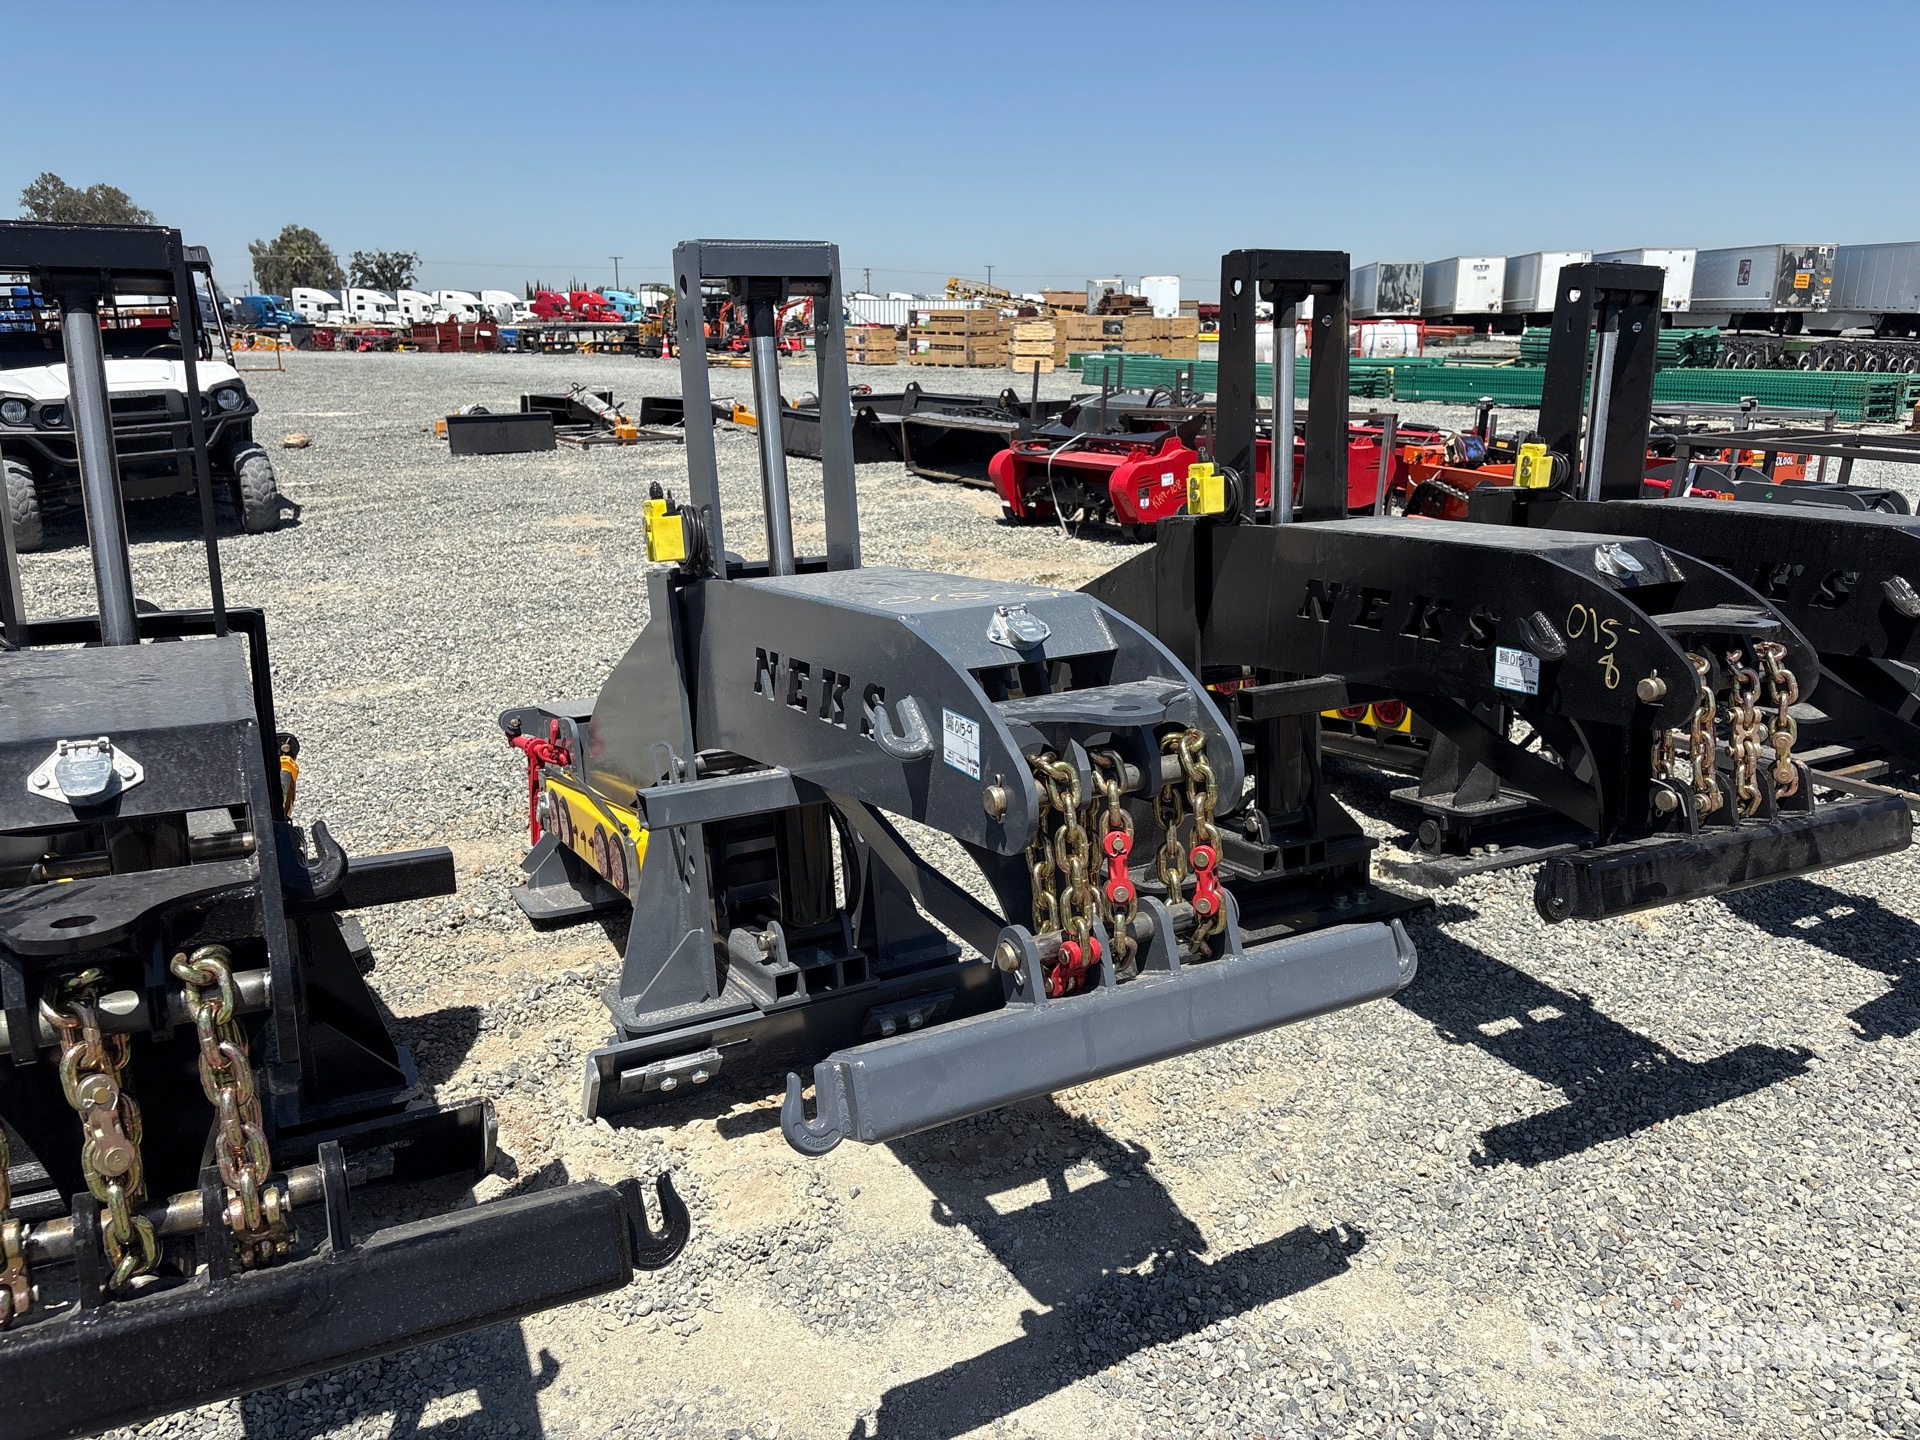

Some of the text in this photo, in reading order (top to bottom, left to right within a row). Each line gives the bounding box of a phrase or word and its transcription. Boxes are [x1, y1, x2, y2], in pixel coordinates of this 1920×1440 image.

[1297, 578, 1502, 650] NEKS
[753, 646, 886, 742] NEKS
[1597, 652, 1621, 690] 8
